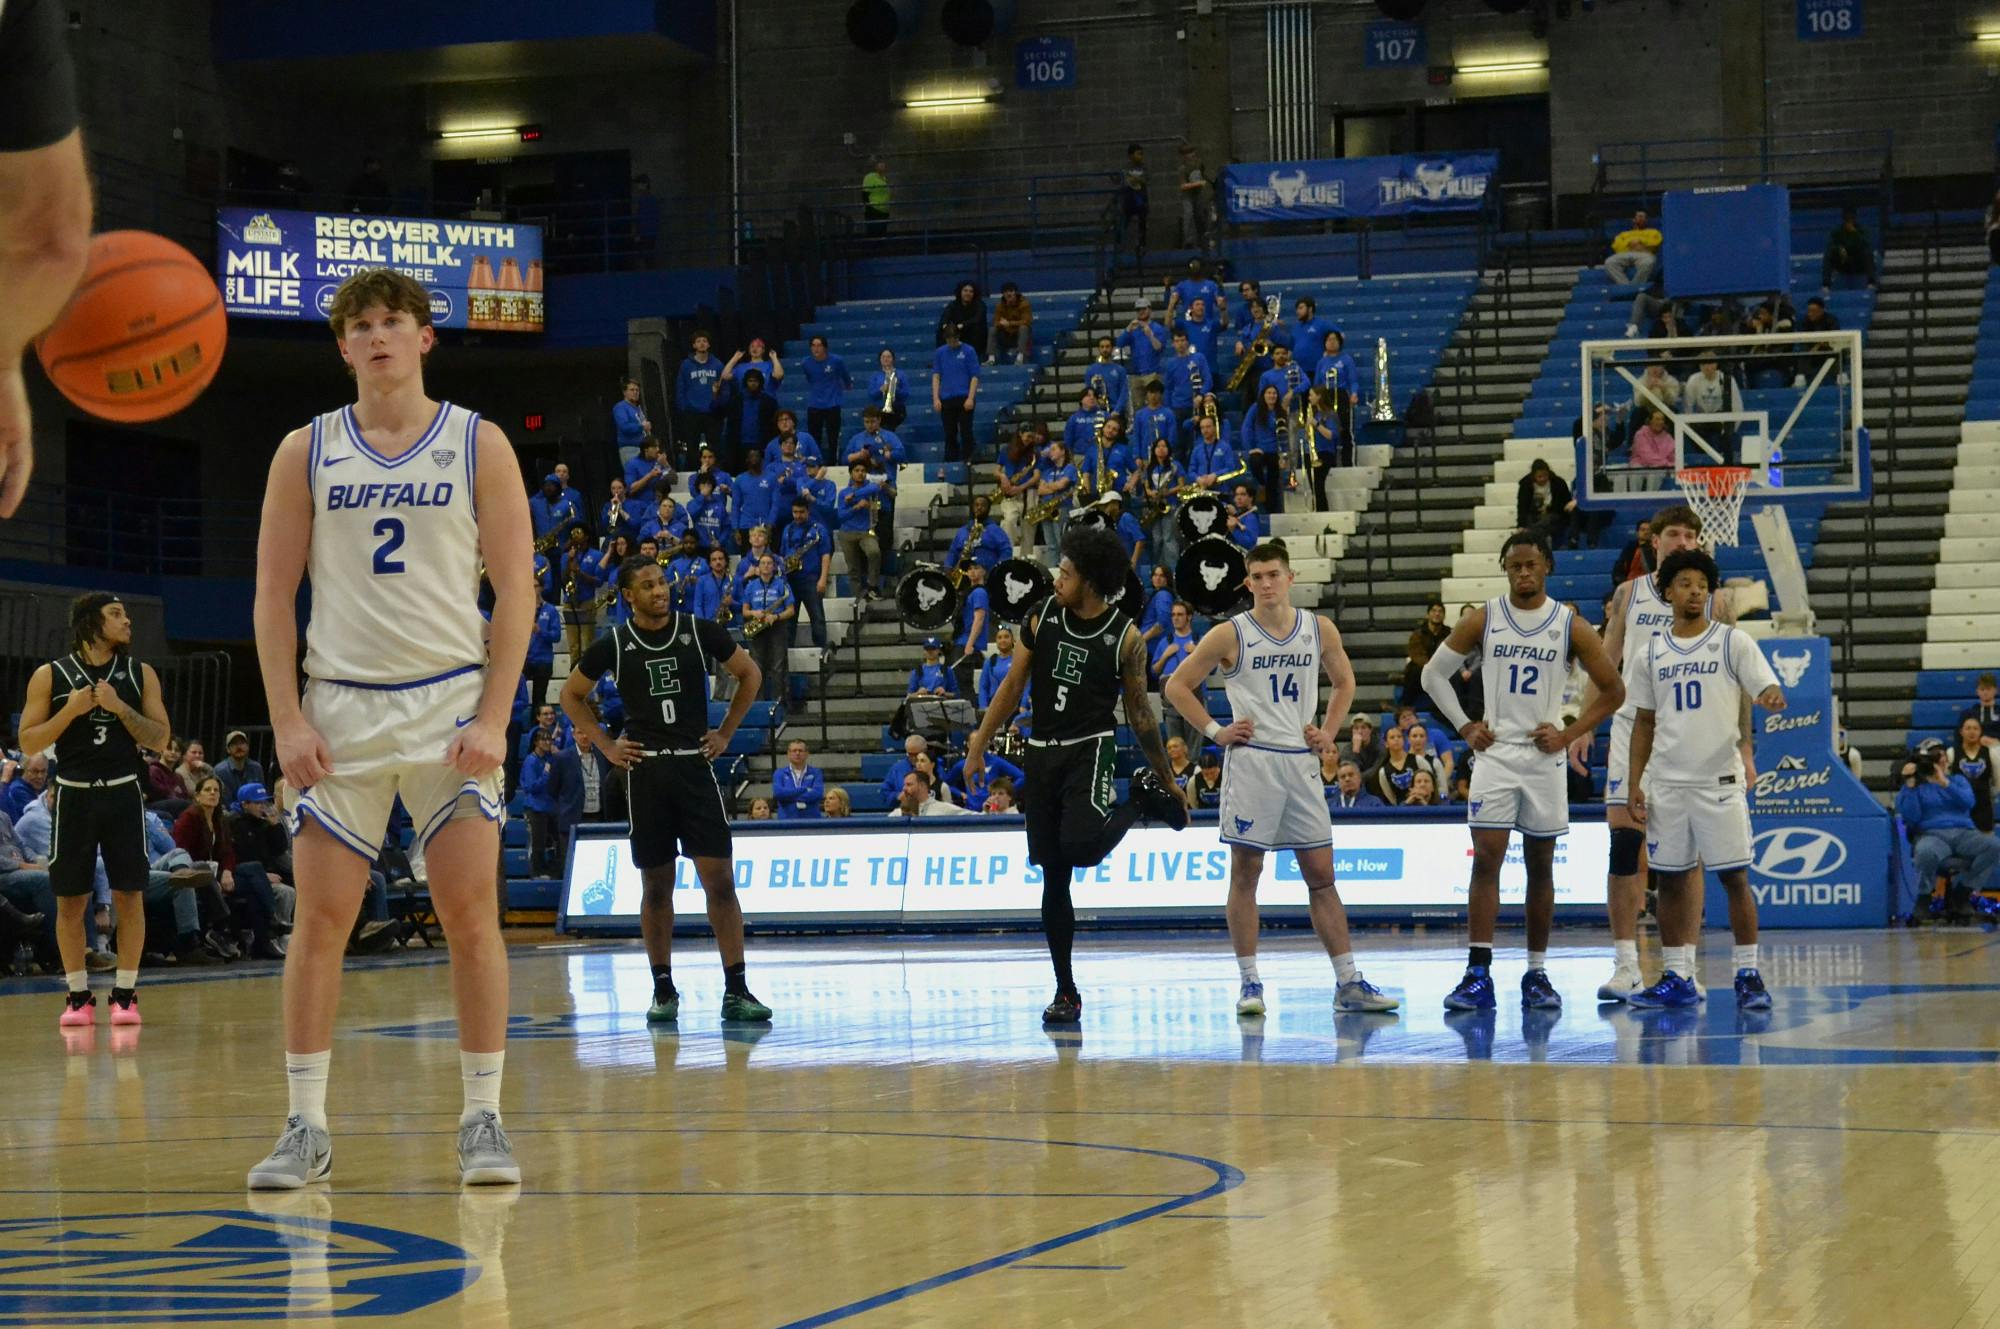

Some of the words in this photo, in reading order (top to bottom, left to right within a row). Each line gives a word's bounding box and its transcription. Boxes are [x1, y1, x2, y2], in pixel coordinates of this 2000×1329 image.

[1808, 9, 1851, 32] 108
[1375, 39, 1416, 60] 107
[1026, 61, 1065, 82] 106
[1234, 187, 1276, 208] TRUE
[1300, 182, 1339, 204] BLUE
[315, 216, 440, 243] RECOVER
[444, 223, 515, 248] WITH
[226, 249, 300, 278] MILK
[316, 238, 386, 262] REAL
[392, 242, 461, 267] MILK.
[226, 278, 236, 304] FOR
[236, 278, 300, 307] LIFE
[525, 415, 542, 428] EXIT
[328, 482, 454, 511] BUFFALO
[372, 517, 406, 575] 2
[1051, 641, 1089, 685] E
[1252, 653, 1313, 669] BUFFALO
[1493, 644, 1558, 662] BUFFALO
[644, 656, 681, 697] E
[1508, 664, 1539, 695] 12
[1658, 661, 1719, 681] BUFFALO
[1054, 684, 1069, 712] 5
[1268, 672, 1299, 703] 14
[1672, 680, 1702, 712] 10
[661, 699, 676, 724] 0
[1765, 710, 1821, 734] Besroi
[93, 725, 108, 745] 3
[1754, 765, 1831, 798] Besroi
[1749, 806, 1843, 815] esroiroofing.com
[768, 858, 850, 888] BLUE
[867, 856, 909, 886] TO
[924, 855, 1009, 886] HELP
[1024, 853, 1112, 884] SVE
[1127, 850, 1226, 882] LIVES
[1289, 858, 1354, 872] Sule
[1356, 858, 1388, 872] Now
[1751, 883, 1861, 905] YUNDAI
